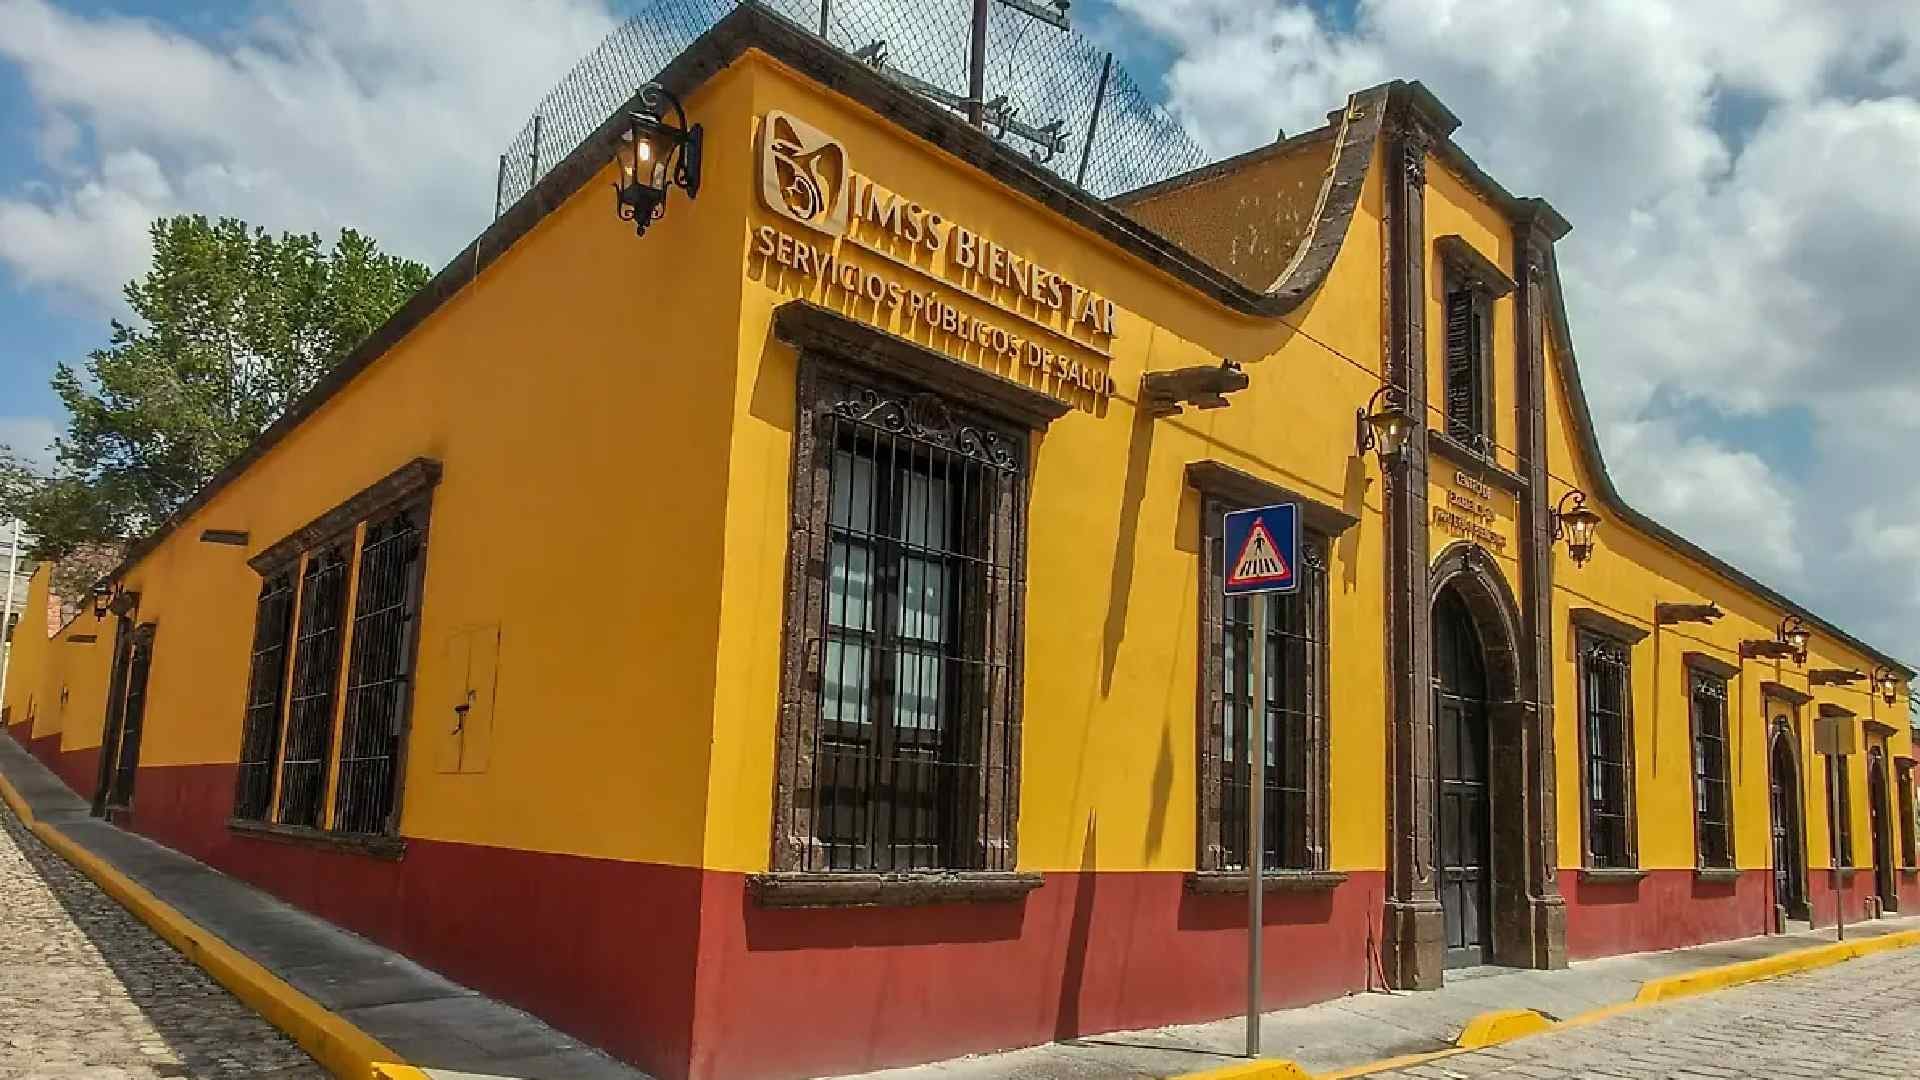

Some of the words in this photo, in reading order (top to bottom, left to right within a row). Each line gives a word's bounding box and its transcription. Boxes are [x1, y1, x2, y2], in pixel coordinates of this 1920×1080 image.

[758, 225, 904, 309] SERVICIOS
[910, 290, 1020, 357] PÚBLICOS
[1028, 341, 1055, 373] DE
[854, 174, 942, 250] IMSS
[955, 225, 1117, 336] BIENESTAR
